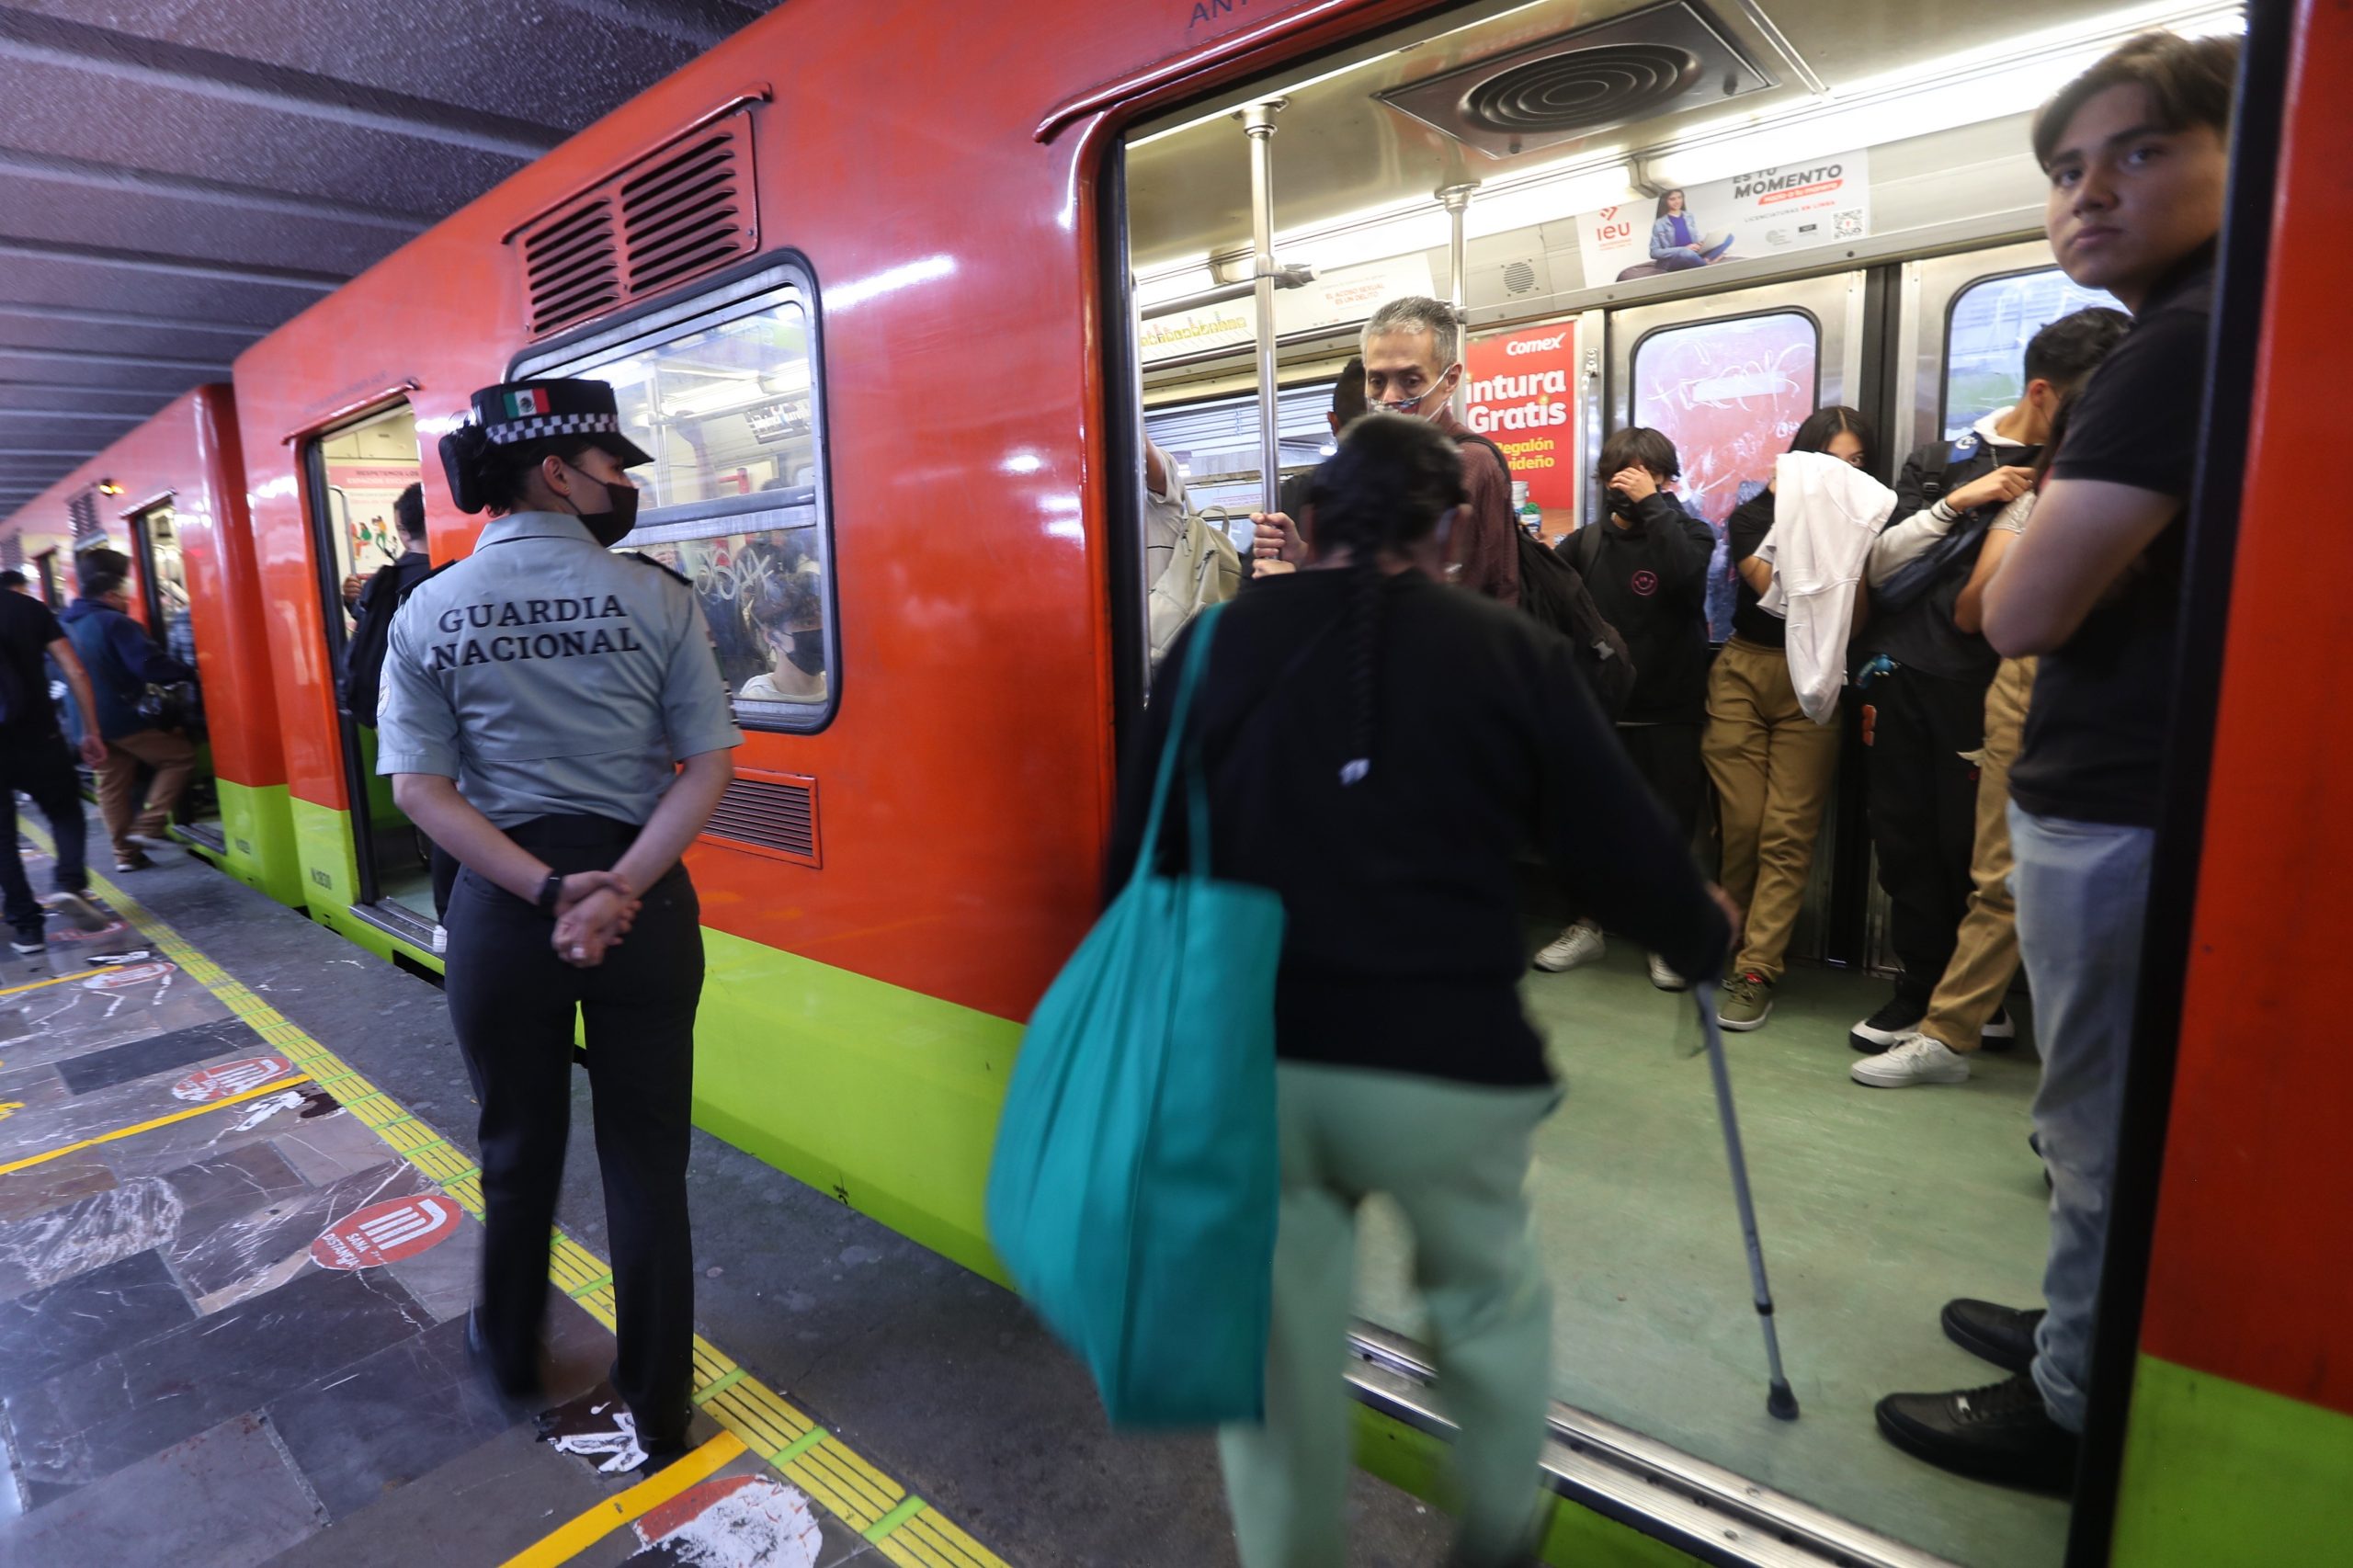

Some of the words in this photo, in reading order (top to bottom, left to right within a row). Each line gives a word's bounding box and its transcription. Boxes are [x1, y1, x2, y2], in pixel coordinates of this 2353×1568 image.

[1188, 0, 1247, 28] AN
[1733, 164, 1843, 199] MOMENTO
[1506, 333, 1566, 356] Comex
[1466, 369, 1566, 404] intura
[1467, 401, 1567, 434] Gratis
[1507, 457, 1555, 471] videño
[438, 594, 628, 633] GUARDIA
[431, 627, 642, 671] NACIONAL
[345, 1233, 371, 1253] SANA
